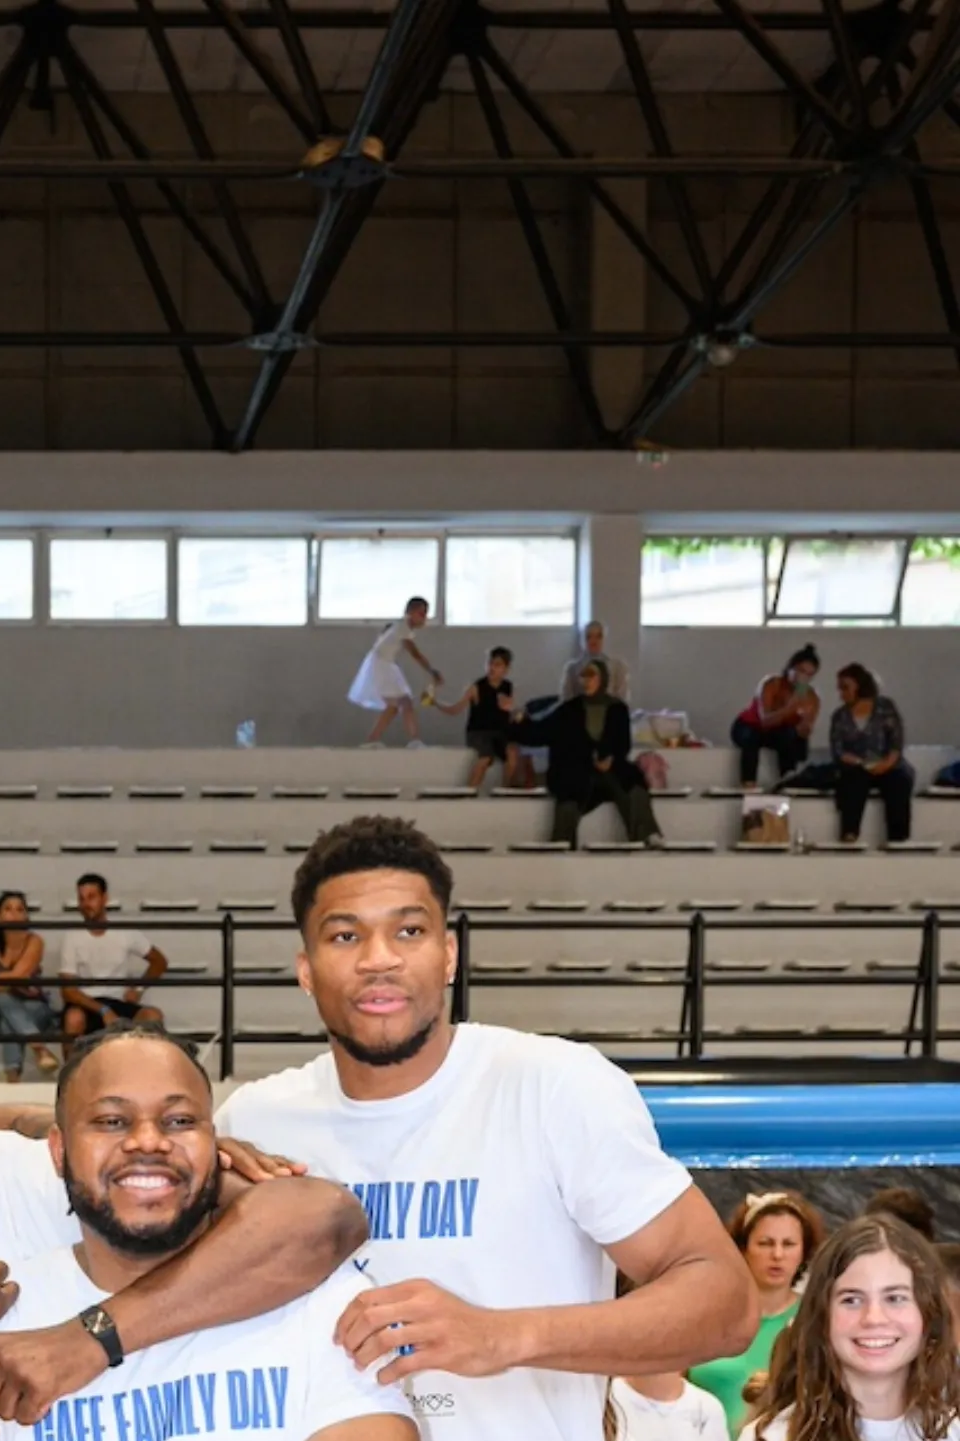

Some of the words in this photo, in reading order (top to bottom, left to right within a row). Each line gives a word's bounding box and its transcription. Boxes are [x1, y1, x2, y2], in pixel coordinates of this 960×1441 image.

[342, 1181, 415, 1240] MILY
[419, 1178, 479, 1239] DAY
[226, 1366, 289, 1430] DAY
